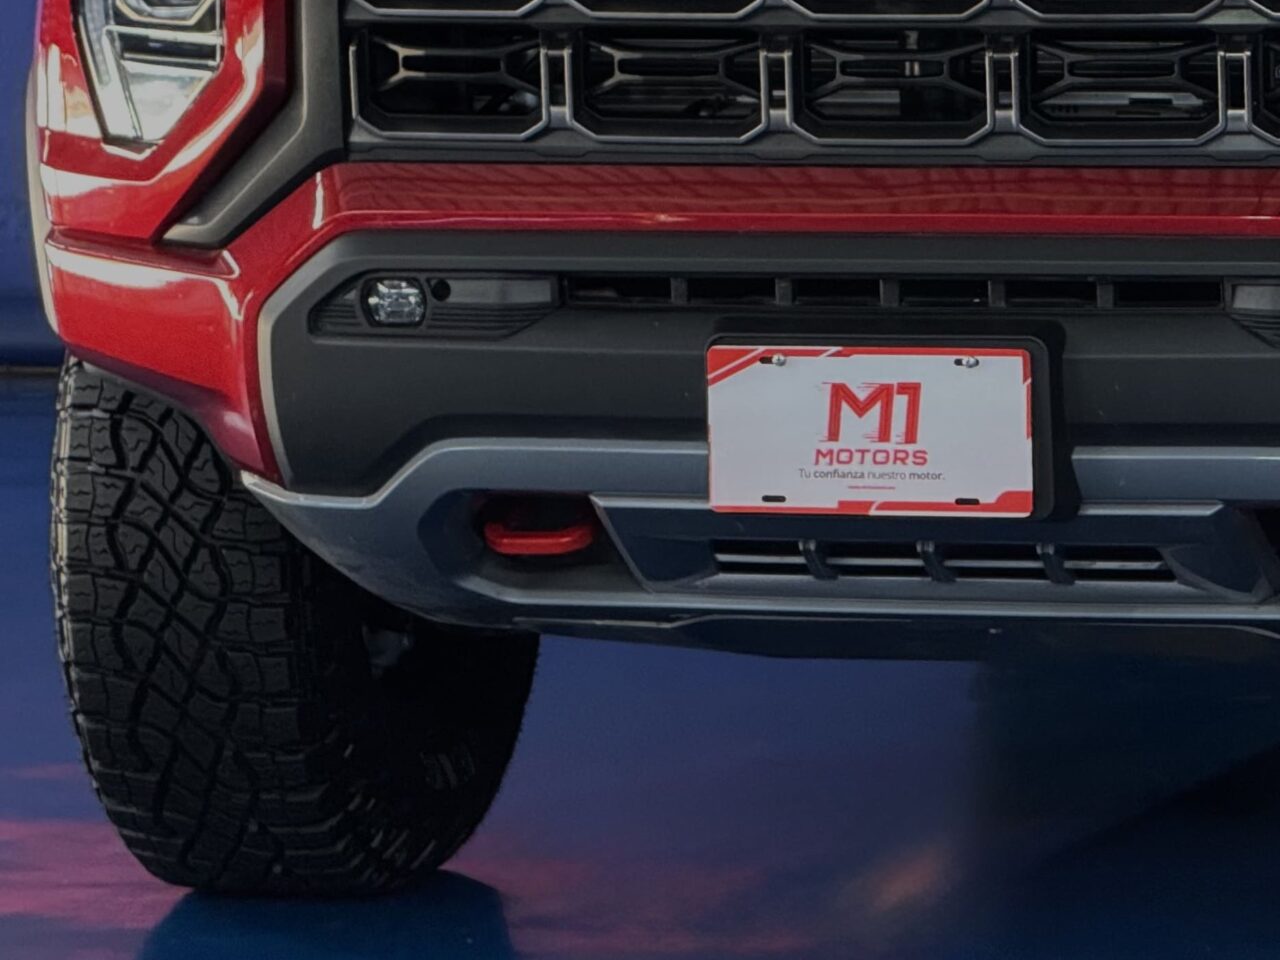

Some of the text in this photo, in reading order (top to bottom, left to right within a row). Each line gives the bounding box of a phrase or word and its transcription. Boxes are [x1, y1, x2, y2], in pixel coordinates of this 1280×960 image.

[820, 382, 921, 444] M1
[814, 448, 928, 466] MOTORS
[798, 468, 946, 481] Tu confianza nuestro motor.
